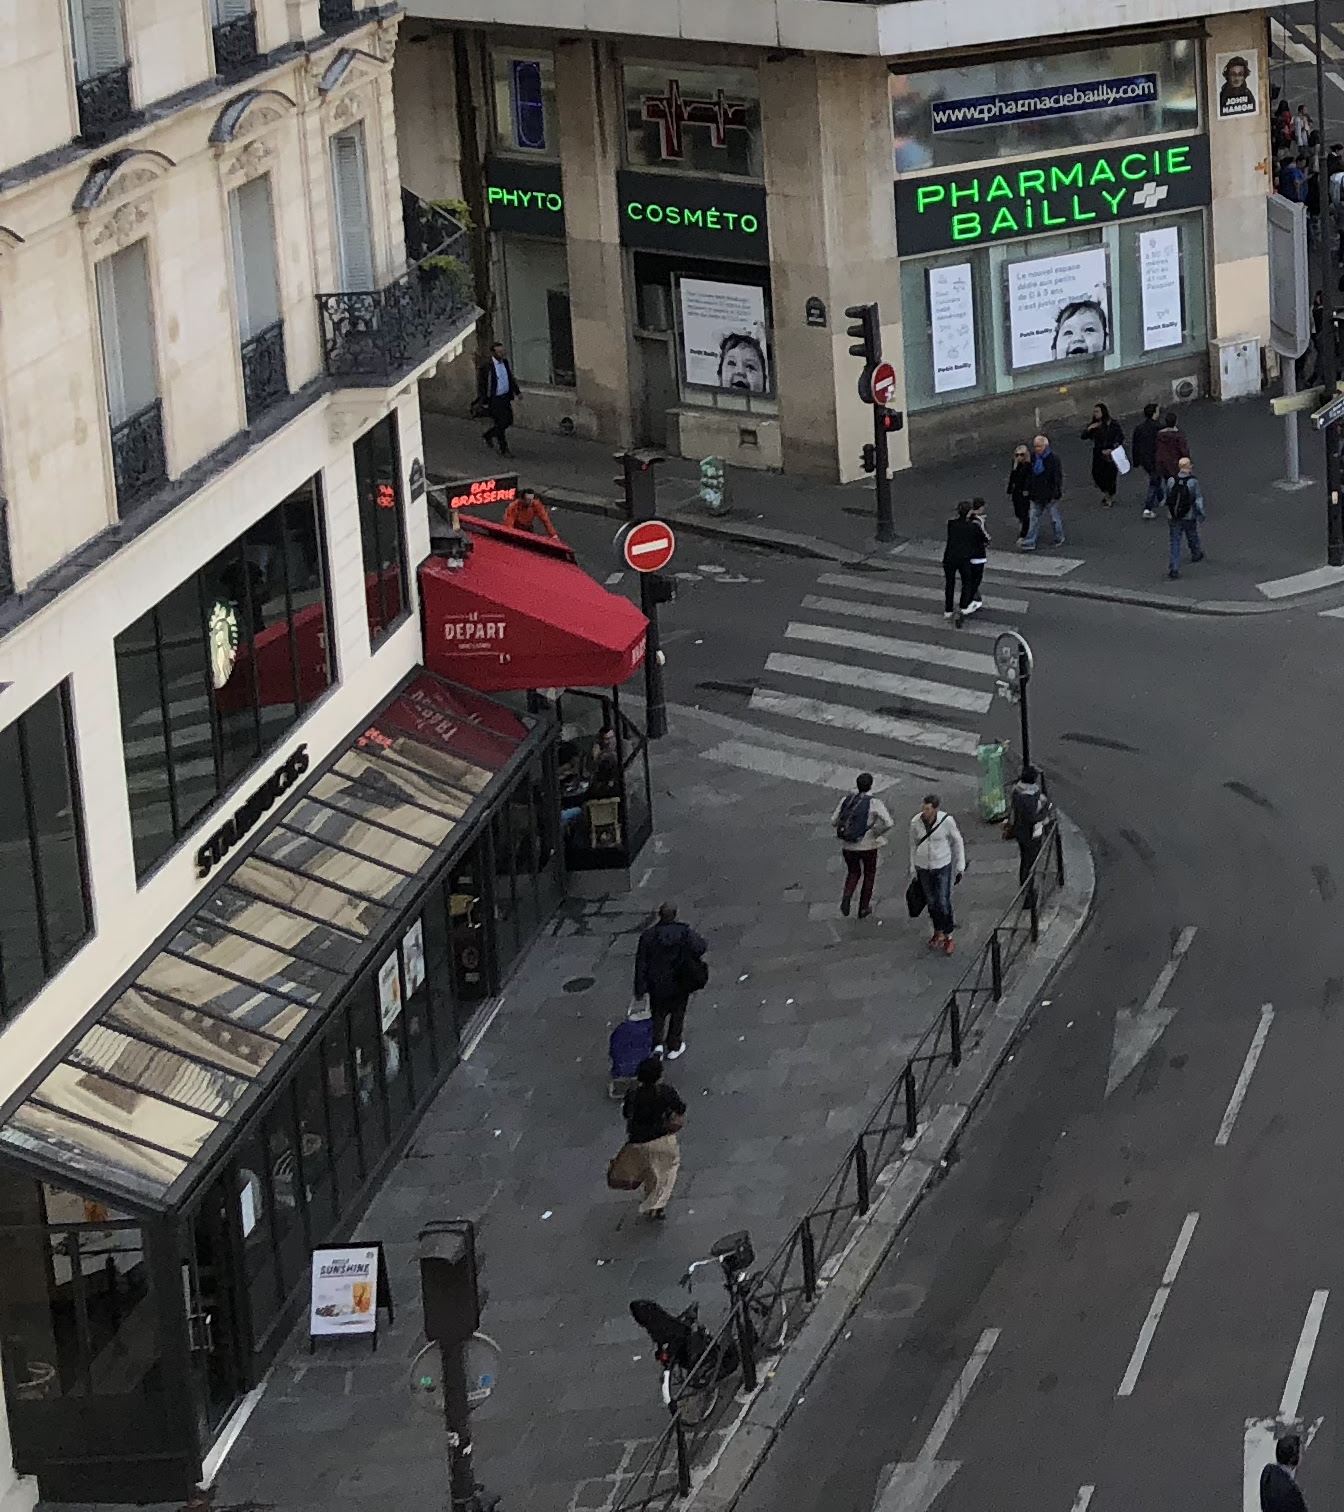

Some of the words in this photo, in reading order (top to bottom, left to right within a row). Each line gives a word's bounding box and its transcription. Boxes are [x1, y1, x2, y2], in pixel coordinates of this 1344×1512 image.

[933, 82, 1155, 124] www.pharmaciebailly.com
[1222, 102, 1254, 115] HAMON
[1226, 94, 1249, 106] JOHN
[916, 145, 1192, 214] PHARMACIE
[488, 187, 563, 212] PHYTO
[627, 202, 758, 234] COSMÉTO
[937, 364, 953, 373] Petit
[470, 479, 496, 493] BAR
[450, 488, 516, 508] BRASSERIE
[444, 622, 506, 640] DEPART
